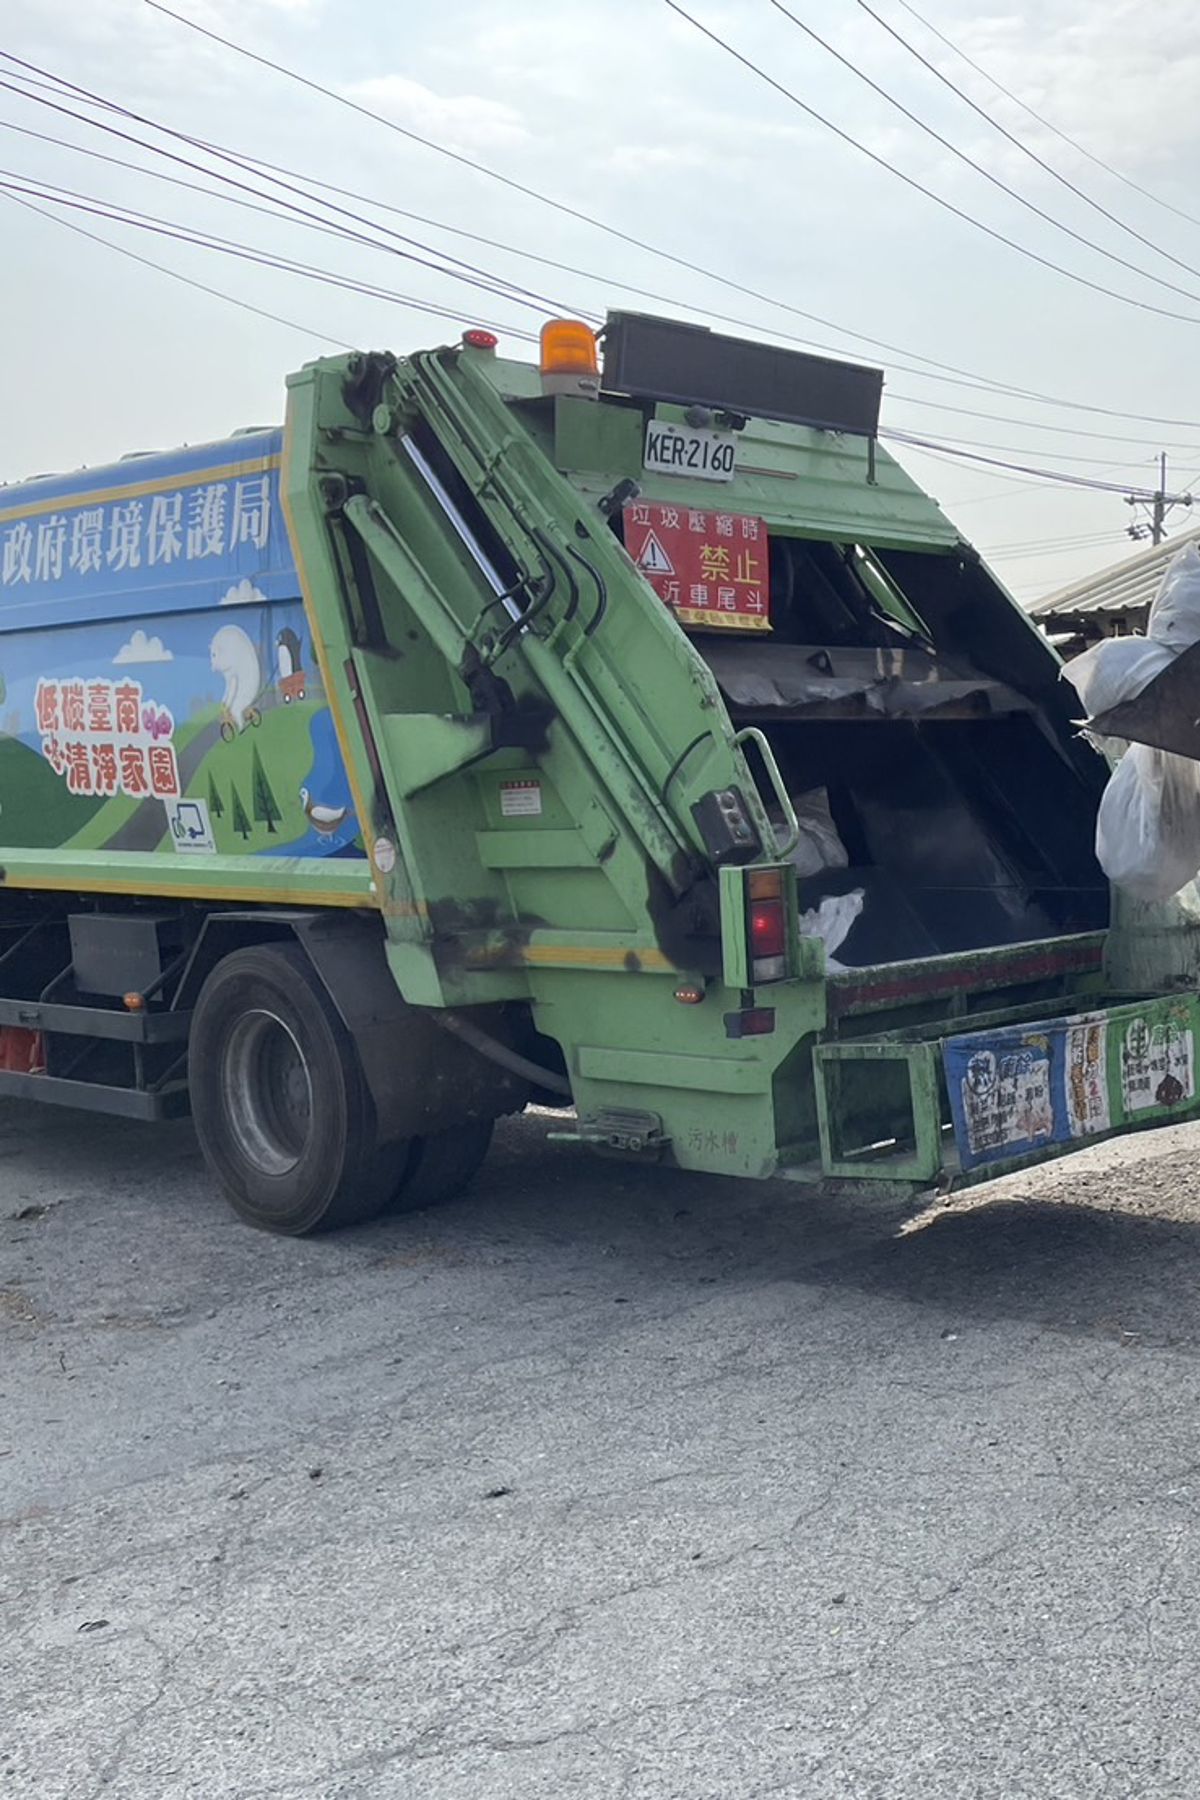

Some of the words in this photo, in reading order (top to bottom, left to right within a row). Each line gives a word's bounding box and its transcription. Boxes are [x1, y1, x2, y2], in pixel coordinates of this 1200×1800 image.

[648, 432, 735, 472] KER-2160
[2, 475, 271, 586] 政府環境保護局
[631, 503, 759, 541] 垃圾壓縮時
[700, 542, 762, 585] 禁止
[652, 579, 763, 613] 近車尾斗
[36, 683, 140, 734] 低碳臺南
[64, 741, 178, 795] 清淨家園
